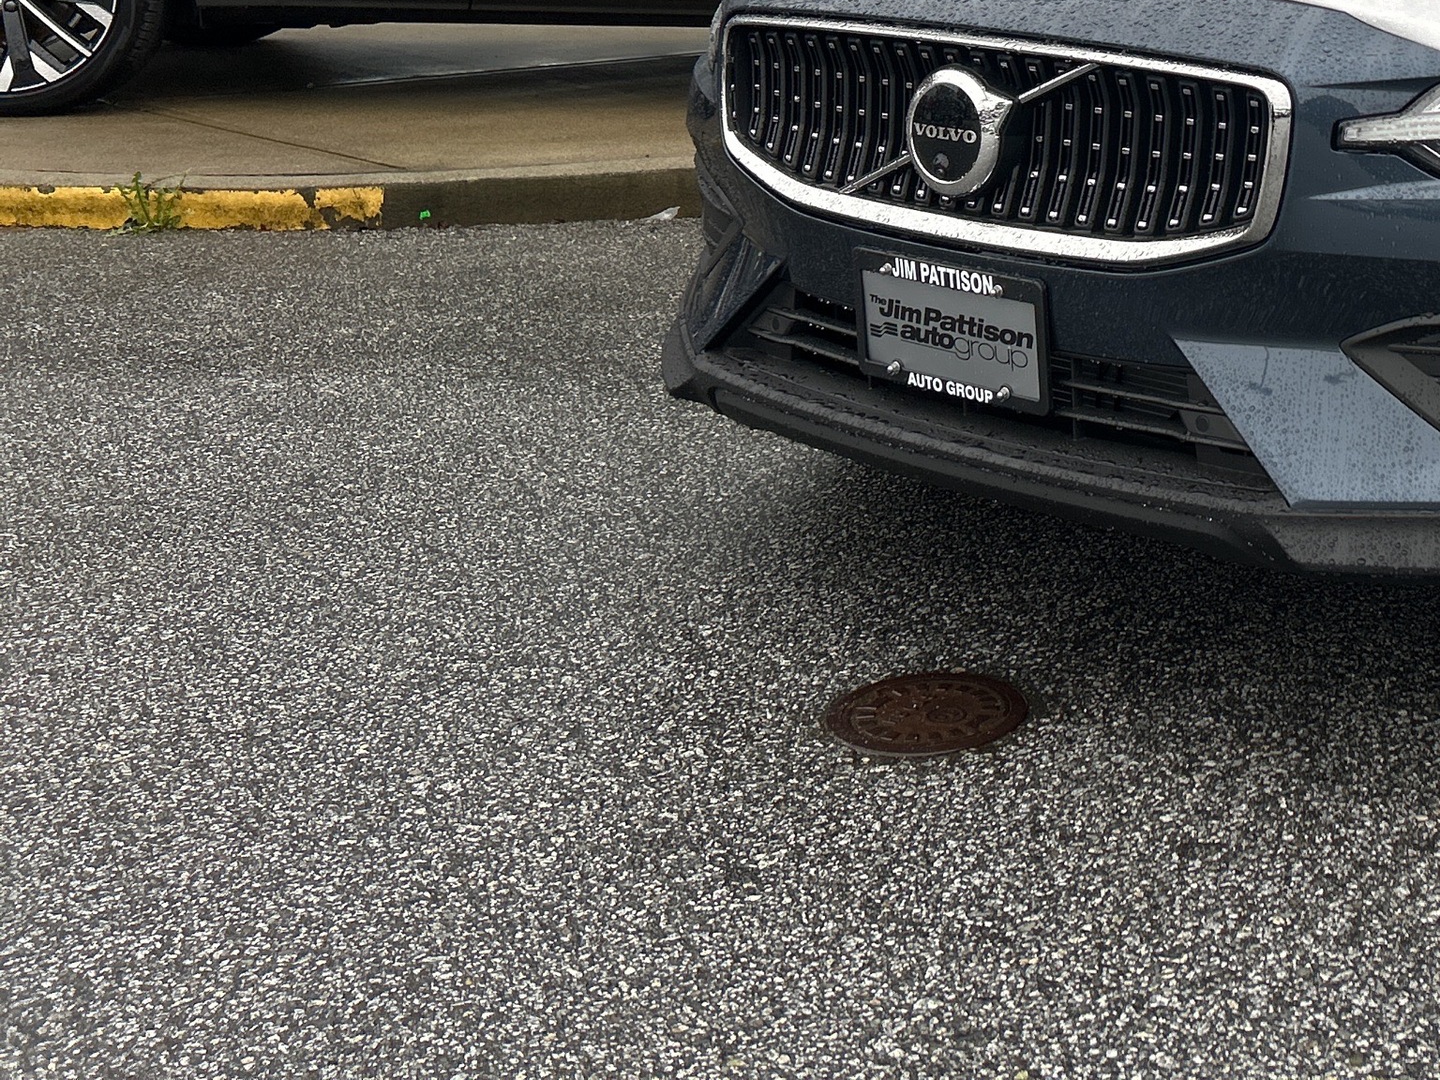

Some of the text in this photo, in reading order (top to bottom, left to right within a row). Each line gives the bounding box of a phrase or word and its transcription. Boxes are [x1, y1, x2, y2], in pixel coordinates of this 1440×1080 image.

[913, 122, 977, 144] VOLVO
[892, 257, 994, 295] JIM PATTISON
[869, 293, 887, 306] The
[907, 371, 993, 404] AUTO GROUP
